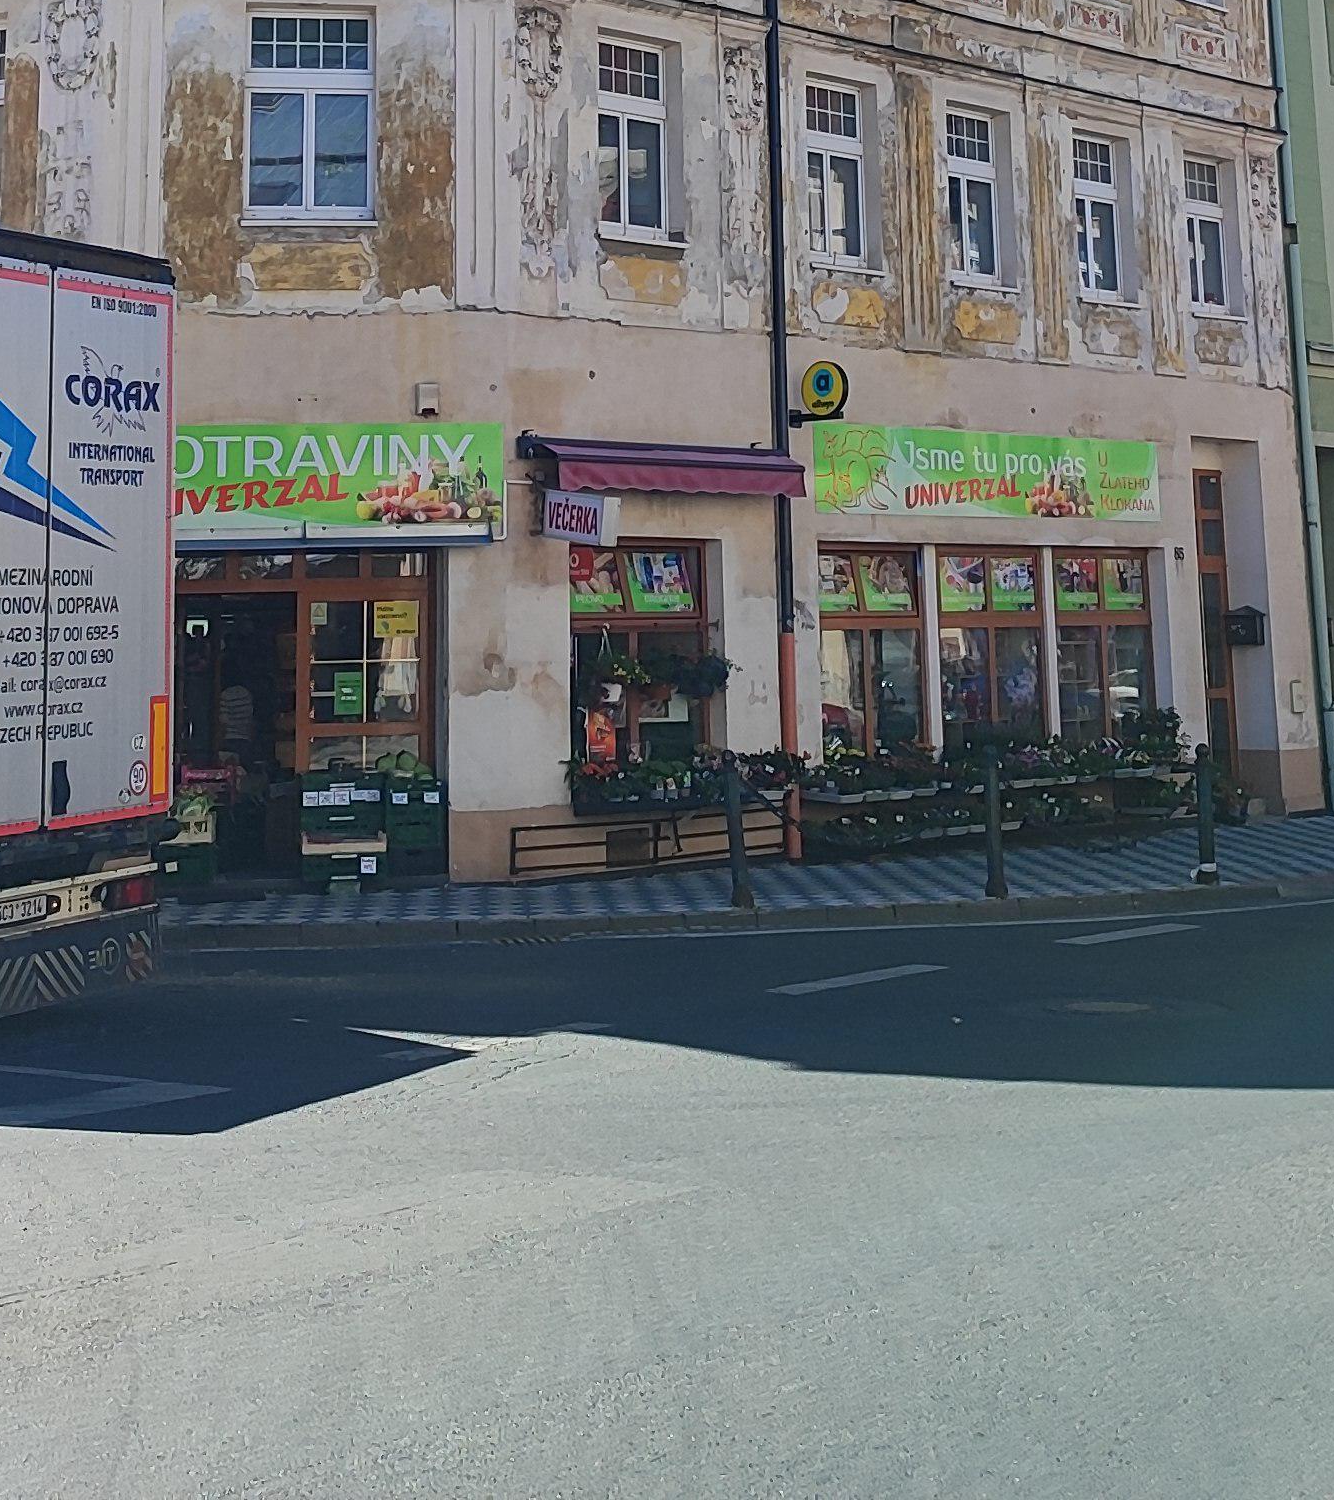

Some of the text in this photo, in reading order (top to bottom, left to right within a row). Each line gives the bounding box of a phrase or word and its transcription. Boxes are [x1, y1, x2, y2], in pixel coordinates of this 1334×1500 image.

[91, 296, 101, 309] EN
[104, 298, 116, 311] ISO
[65, 375, 161, 412] CORAX
[68, 442, 155, 463] INTERNATIONAL
[175, 434, 475, 478] OTRAVINY
[904, 440, 1087, 479] Jsme tu pro vás
[1097, 451, 1108, 467] U
[80, 468, 144, 487] TRANSPORT
[174, 472, 349, 516] IVERZAL
[904, 474, 1022, 509] UNIVERZAL
[548, 498, 598, 535] VEČERKA
[57, 596, 119, 613] DOPRAVA
[64, 626, 82, 641] 001
[86, 625, 119, 641] 692-5
[3, 652, 36, 667] +420
[68, 650, 86, 665] 001
[91, 649, 114, 664] 690
[21, 675, 107, 693] corax@corax.cz
[36, 721, 94, 741] REPUBLIC
[133, 735, 144, 749] CZ
[133, 767, 144, 783] 90
